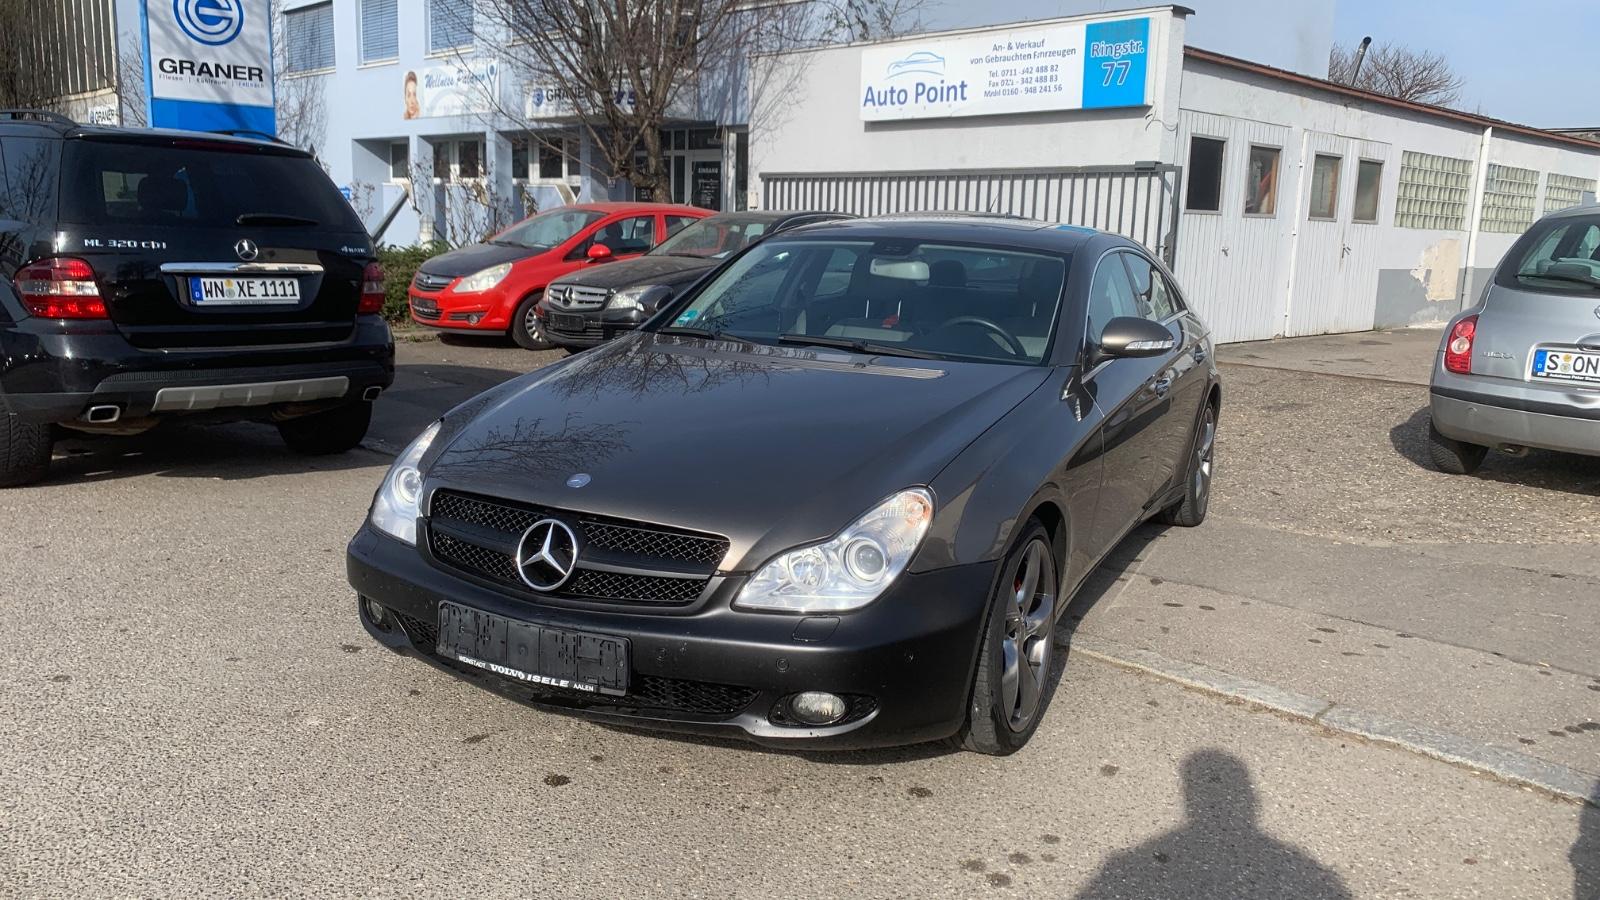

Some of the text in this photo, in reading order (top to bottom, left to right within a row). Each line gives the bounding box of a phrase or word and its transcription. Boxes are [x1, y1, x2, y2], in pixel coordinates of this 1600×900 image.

[993, 39, 1046, 52] An- & Verkauf
[1091, 40, 1144, 59] Ringstr.
[985, 53, 1032, 64] Gebrauchten
[158, 58, 264, 82] GRANER
[1001, 69, 1017, 77] 0711
[1050, 64, 1059, 72] 82
[1049, 74, 1058, 82] 83
[1102, 61, 1131, 86] 77
[863, 80, 968, 107] Auto Point
[1002, 87, 1019, 96] 0160
[1025, 86, 1037, 95] 948
[1039, 85, 1051, 93] 241
[84, 239, 104, 247] ML
[107, 239, 138, 248] 320
[203, 281, 225, 298] WN
[237, 281, 257, 297] XE
[260, 280, 298, 297] 1111
[1547, 354, 1560, 371] S
[1573, 356, 1599, 375] ON
[489, 663, 525, 680] VOLVO
[526, 674, 570, 688] ISELE
[573, 682, 594, 692] AALEN
